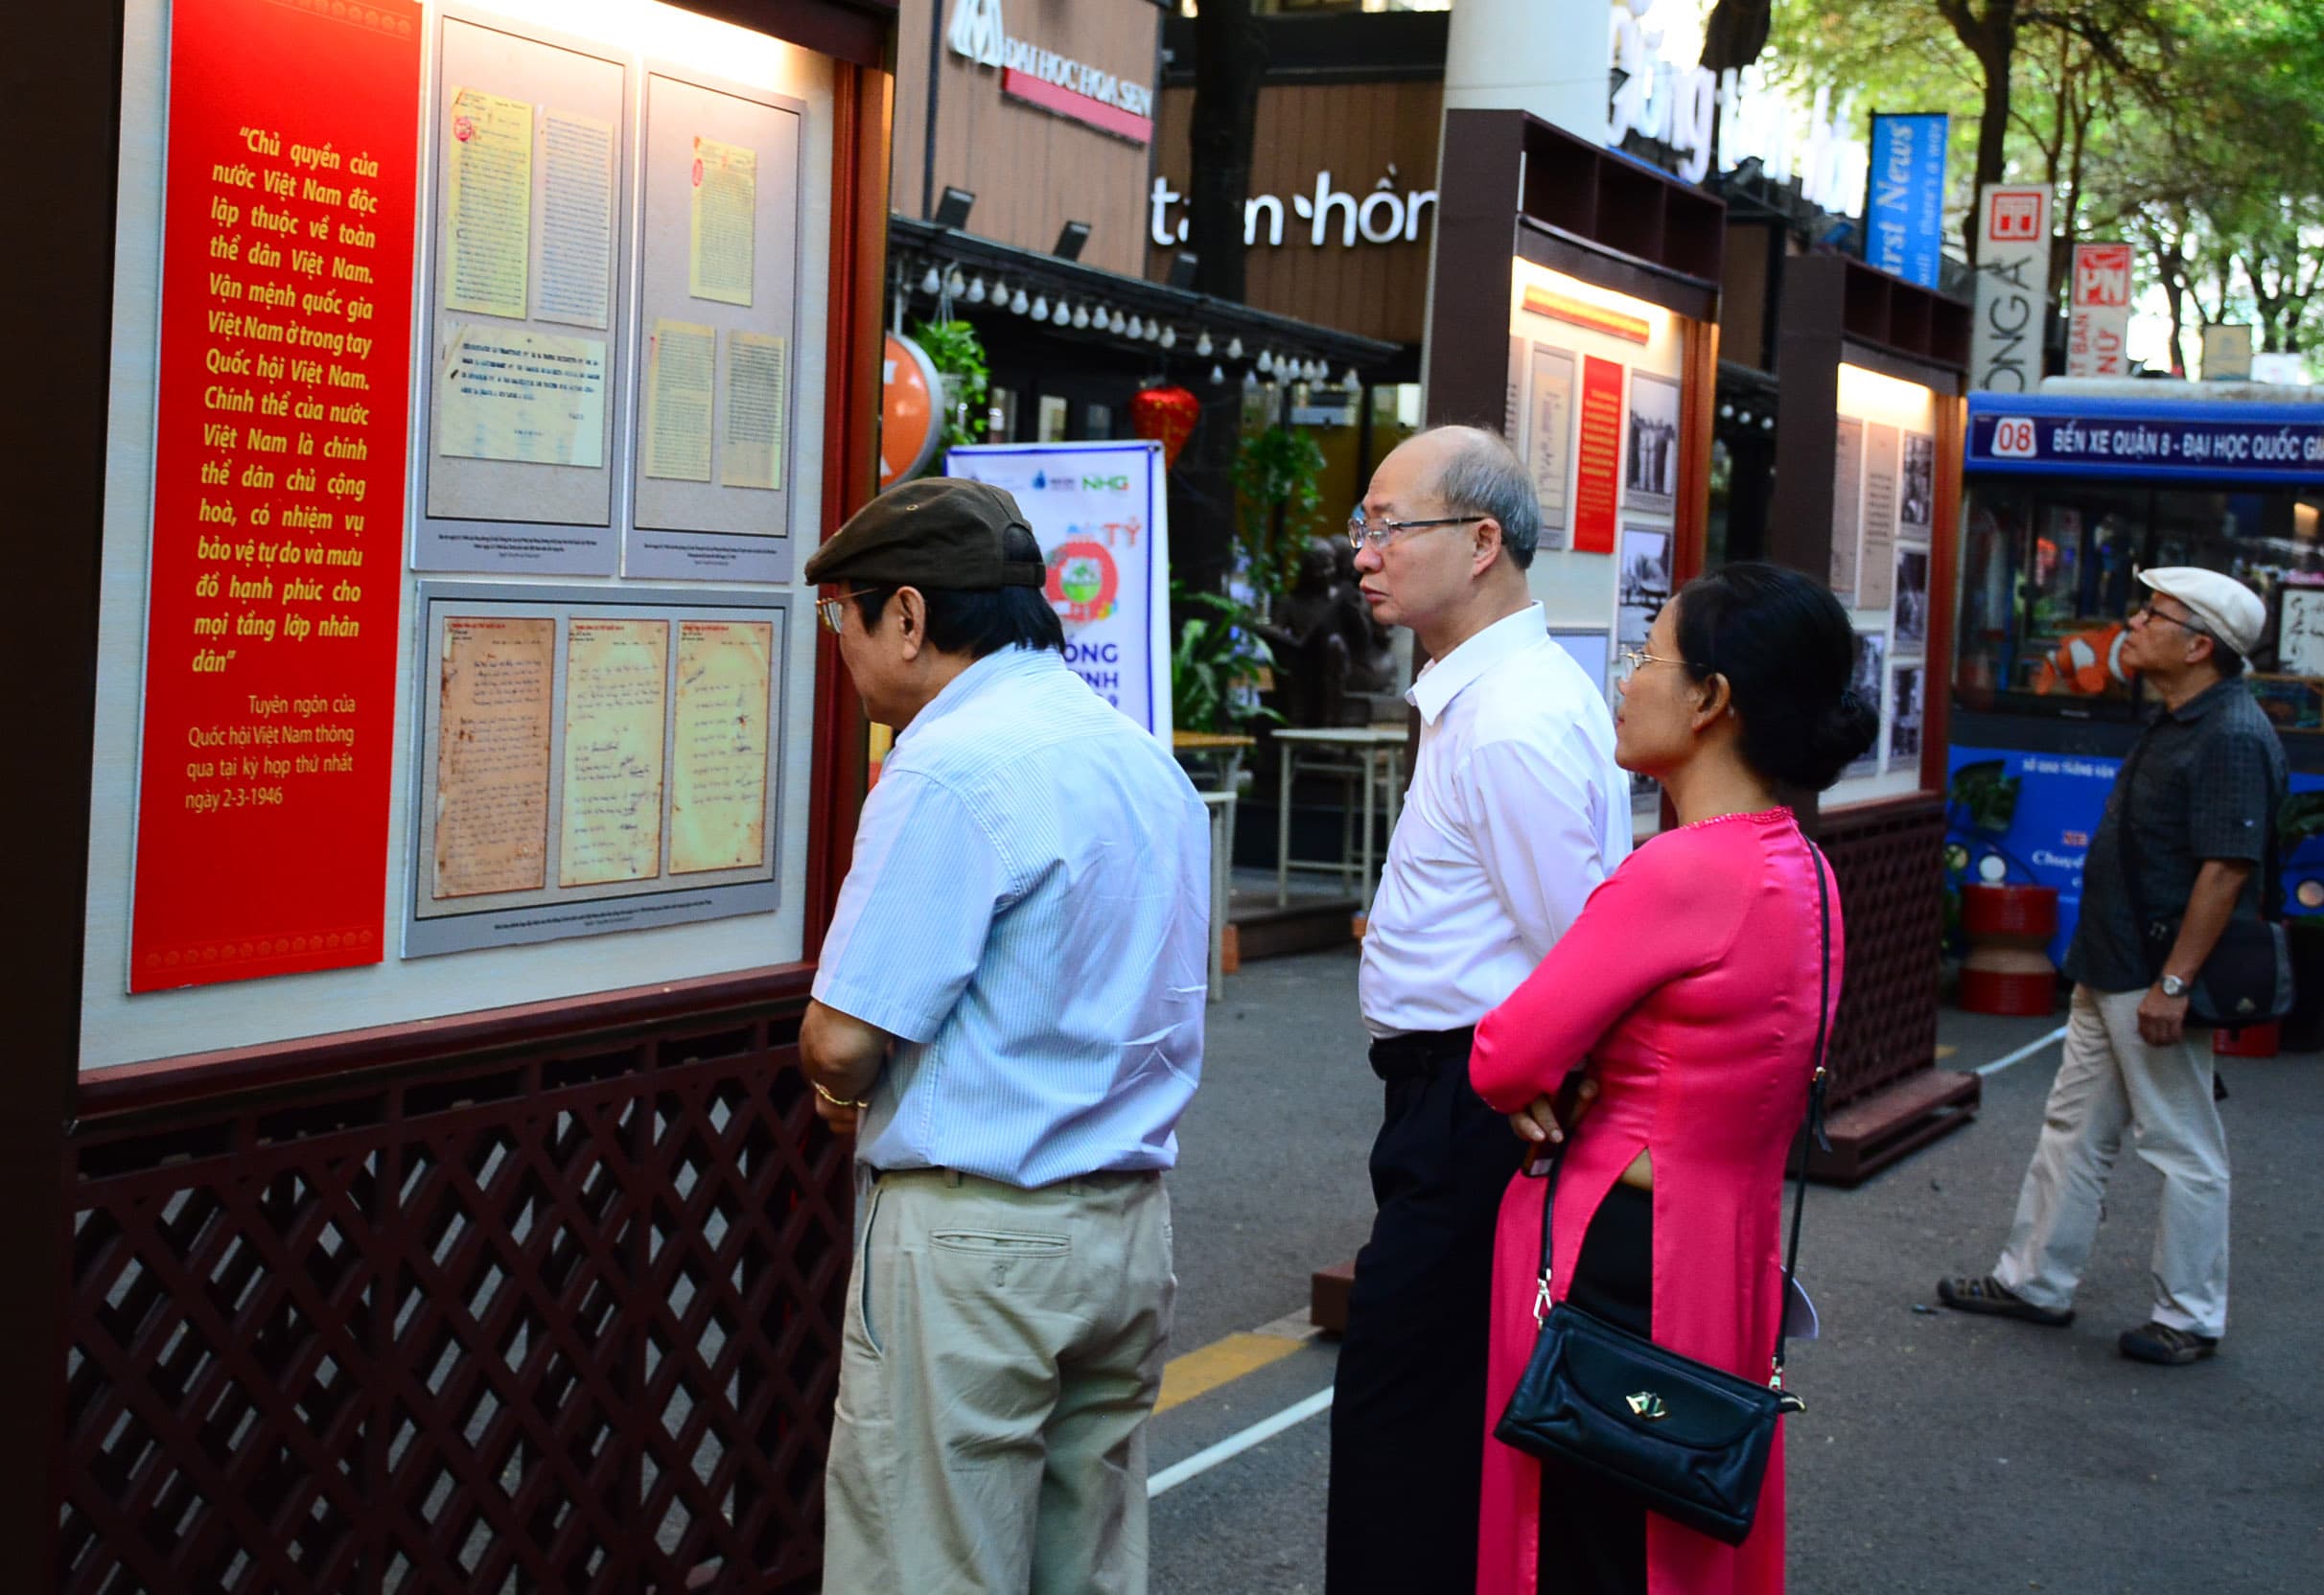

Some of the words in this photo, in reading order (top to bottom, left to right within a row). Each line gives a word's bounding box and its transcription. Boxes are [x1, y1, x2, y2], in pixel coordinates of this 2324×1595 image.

[290, 143, 340, 171] quyền
[350, 151, 379, 177] của
[1875, 125, 1914, 213] News
[213, 164, 256, 189] nước
[265, 170, 296, 201] Việt
[303, 178, 341, 205] Nam
[348, 188, 378, 217] độc
[211, 196, 239, 227] lập
[251, 205, 299, 238] thuộc
[310, 215, 330, 240] về
[339, 223, 375, 248] toàn
[210, 234, 241, 261] thể
[248, 242, 281, 267] dân
[292, 249, 324, 280] Việt
[332, 257, 373, 284] Nam.
[210, 272, 242, 303] Vận
[248, 282, 296, 310] mệnh
[302, 289, 342, 315] quốc
[347, 296, 373, 322] gia
[209, 311, 243, 341] Việt
[244, 315, 283, 341] Nam
[287, 320, 299, 343] ở
[300, 327, 344, 357] trong
[346, 333, 372, 359] tay
[206, 348, 251, 375] Quốc
[257, 354, 285, 384] hội
[291, 359, 323, 389] Việt
[328, 364, 369, 390] Nam.
[205, 386, 254, 412] Chính
[262, 391, 290, 416] thể
[295, 396, 324, 420] của
[330, 403, 369, 425] nước
[204, 424, 238, 453] Việt
[247, 428, 287, 452] Nam
[298, 432, 314, 455] là
[324, 436, 367, 460] chính
[1997, 423, 2033, 451] 08
[2053, 421, 2085, 453] BẾN
[2088, 429, 2109, 454] XE
[2112, 426, 2157, 460] QUẬN
[2160, 432, 2172, 456] 8
[2252, 426, 2301, 460] QUỐC
[2303, 435, 2324, 460] GI
[201, 459, 232, 485] thể
[242, 464, 274, 488] dân
[287, 468, 315, 491] chủ
[328, 473, 365, 501] cộng
[1081, 474, 1129, 491] NHG
[199, 498, 237, 526] hoà,
[251, 503, 269, 525] có
[282, 504, 333, 534] nhiệm
[345, 515, 364, 537] vụ
[198, 536, 231, 560] bảo
[236, 539, 255, 567] vệ
[259, 543, 279, 568] tự
[280, 541, 301, 564] do
[305, 543, 324, 565] và
[327, 547, 362, 566] mưu
[229, 575, 273, 604] hạnh
[282, 577, 323, 605] phúc
[333, 580, 360, 602] cho
[195, 613, 229, 640] mọi
[284, 613, 311, 641] lớp
[318, 614, 360, 636] nhân
[248, 695, 288, 718] Tuyên
[293, 695, 328, 718] ngôn
[333, 694, 356, 712] của
[189, 725, 226, 748] Quốc
[229, 727, 251, 749] hội
[253, 726, 279, 749] Việt
[282, 726, 313, 743] Nam
[315, 725, 354, 747] thông
[187, 763, 214, 781] qua
[220, 758, 237, 779] tại
[243, 757, 258, 779] kỳ
[264, 756, 290, 778] họp
[296, 755, 319, 773] thứ
[324, 752, 353, 772] nhất
[186, 790, 220, 813] ngày
[223, 787, 283, 807] 2-3-1946
